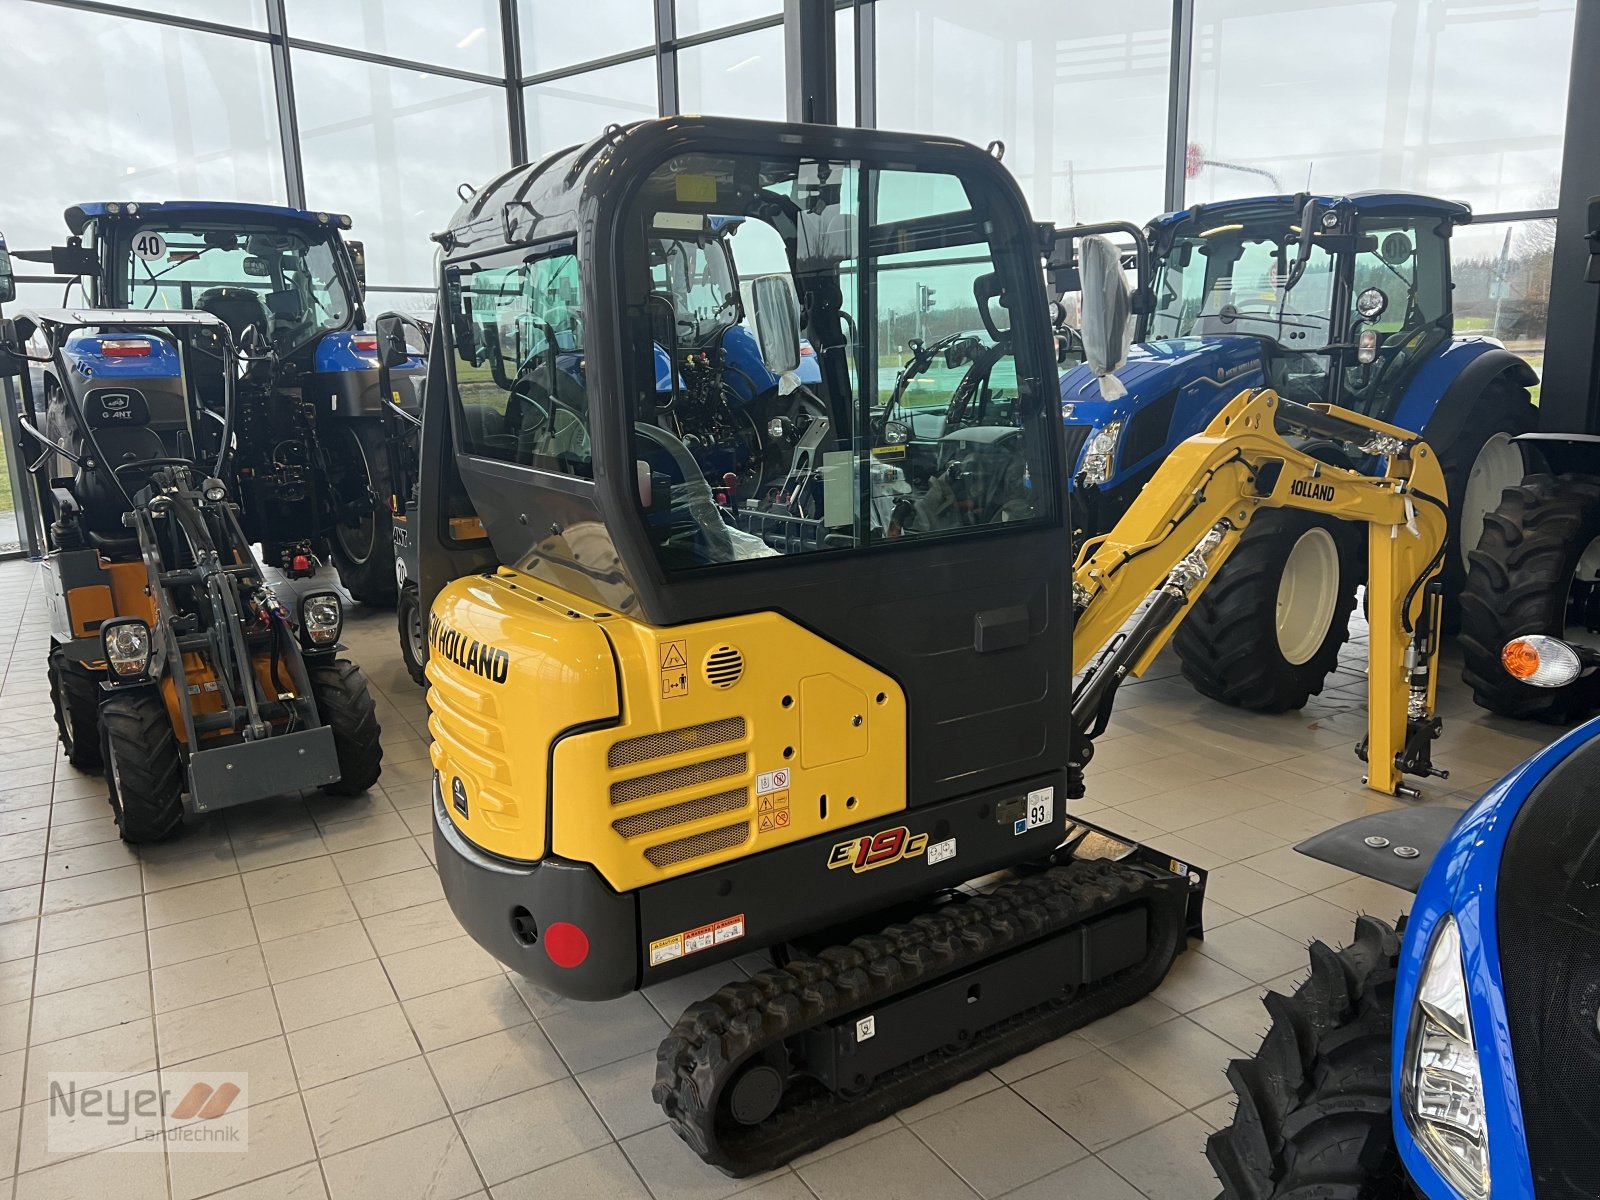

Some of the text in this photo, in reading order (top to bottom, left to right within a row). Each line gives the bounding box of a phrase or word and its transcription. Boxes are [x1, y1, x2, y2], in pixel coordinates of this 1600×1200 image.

[137, 236, 160, 256] 40
[102, 410, 132, 419] GANT
[439, 623, 509, 685] HOLLAND
[1031, 805, 1045, 824] 93
[659, 937, 679, 947] CAUTION
